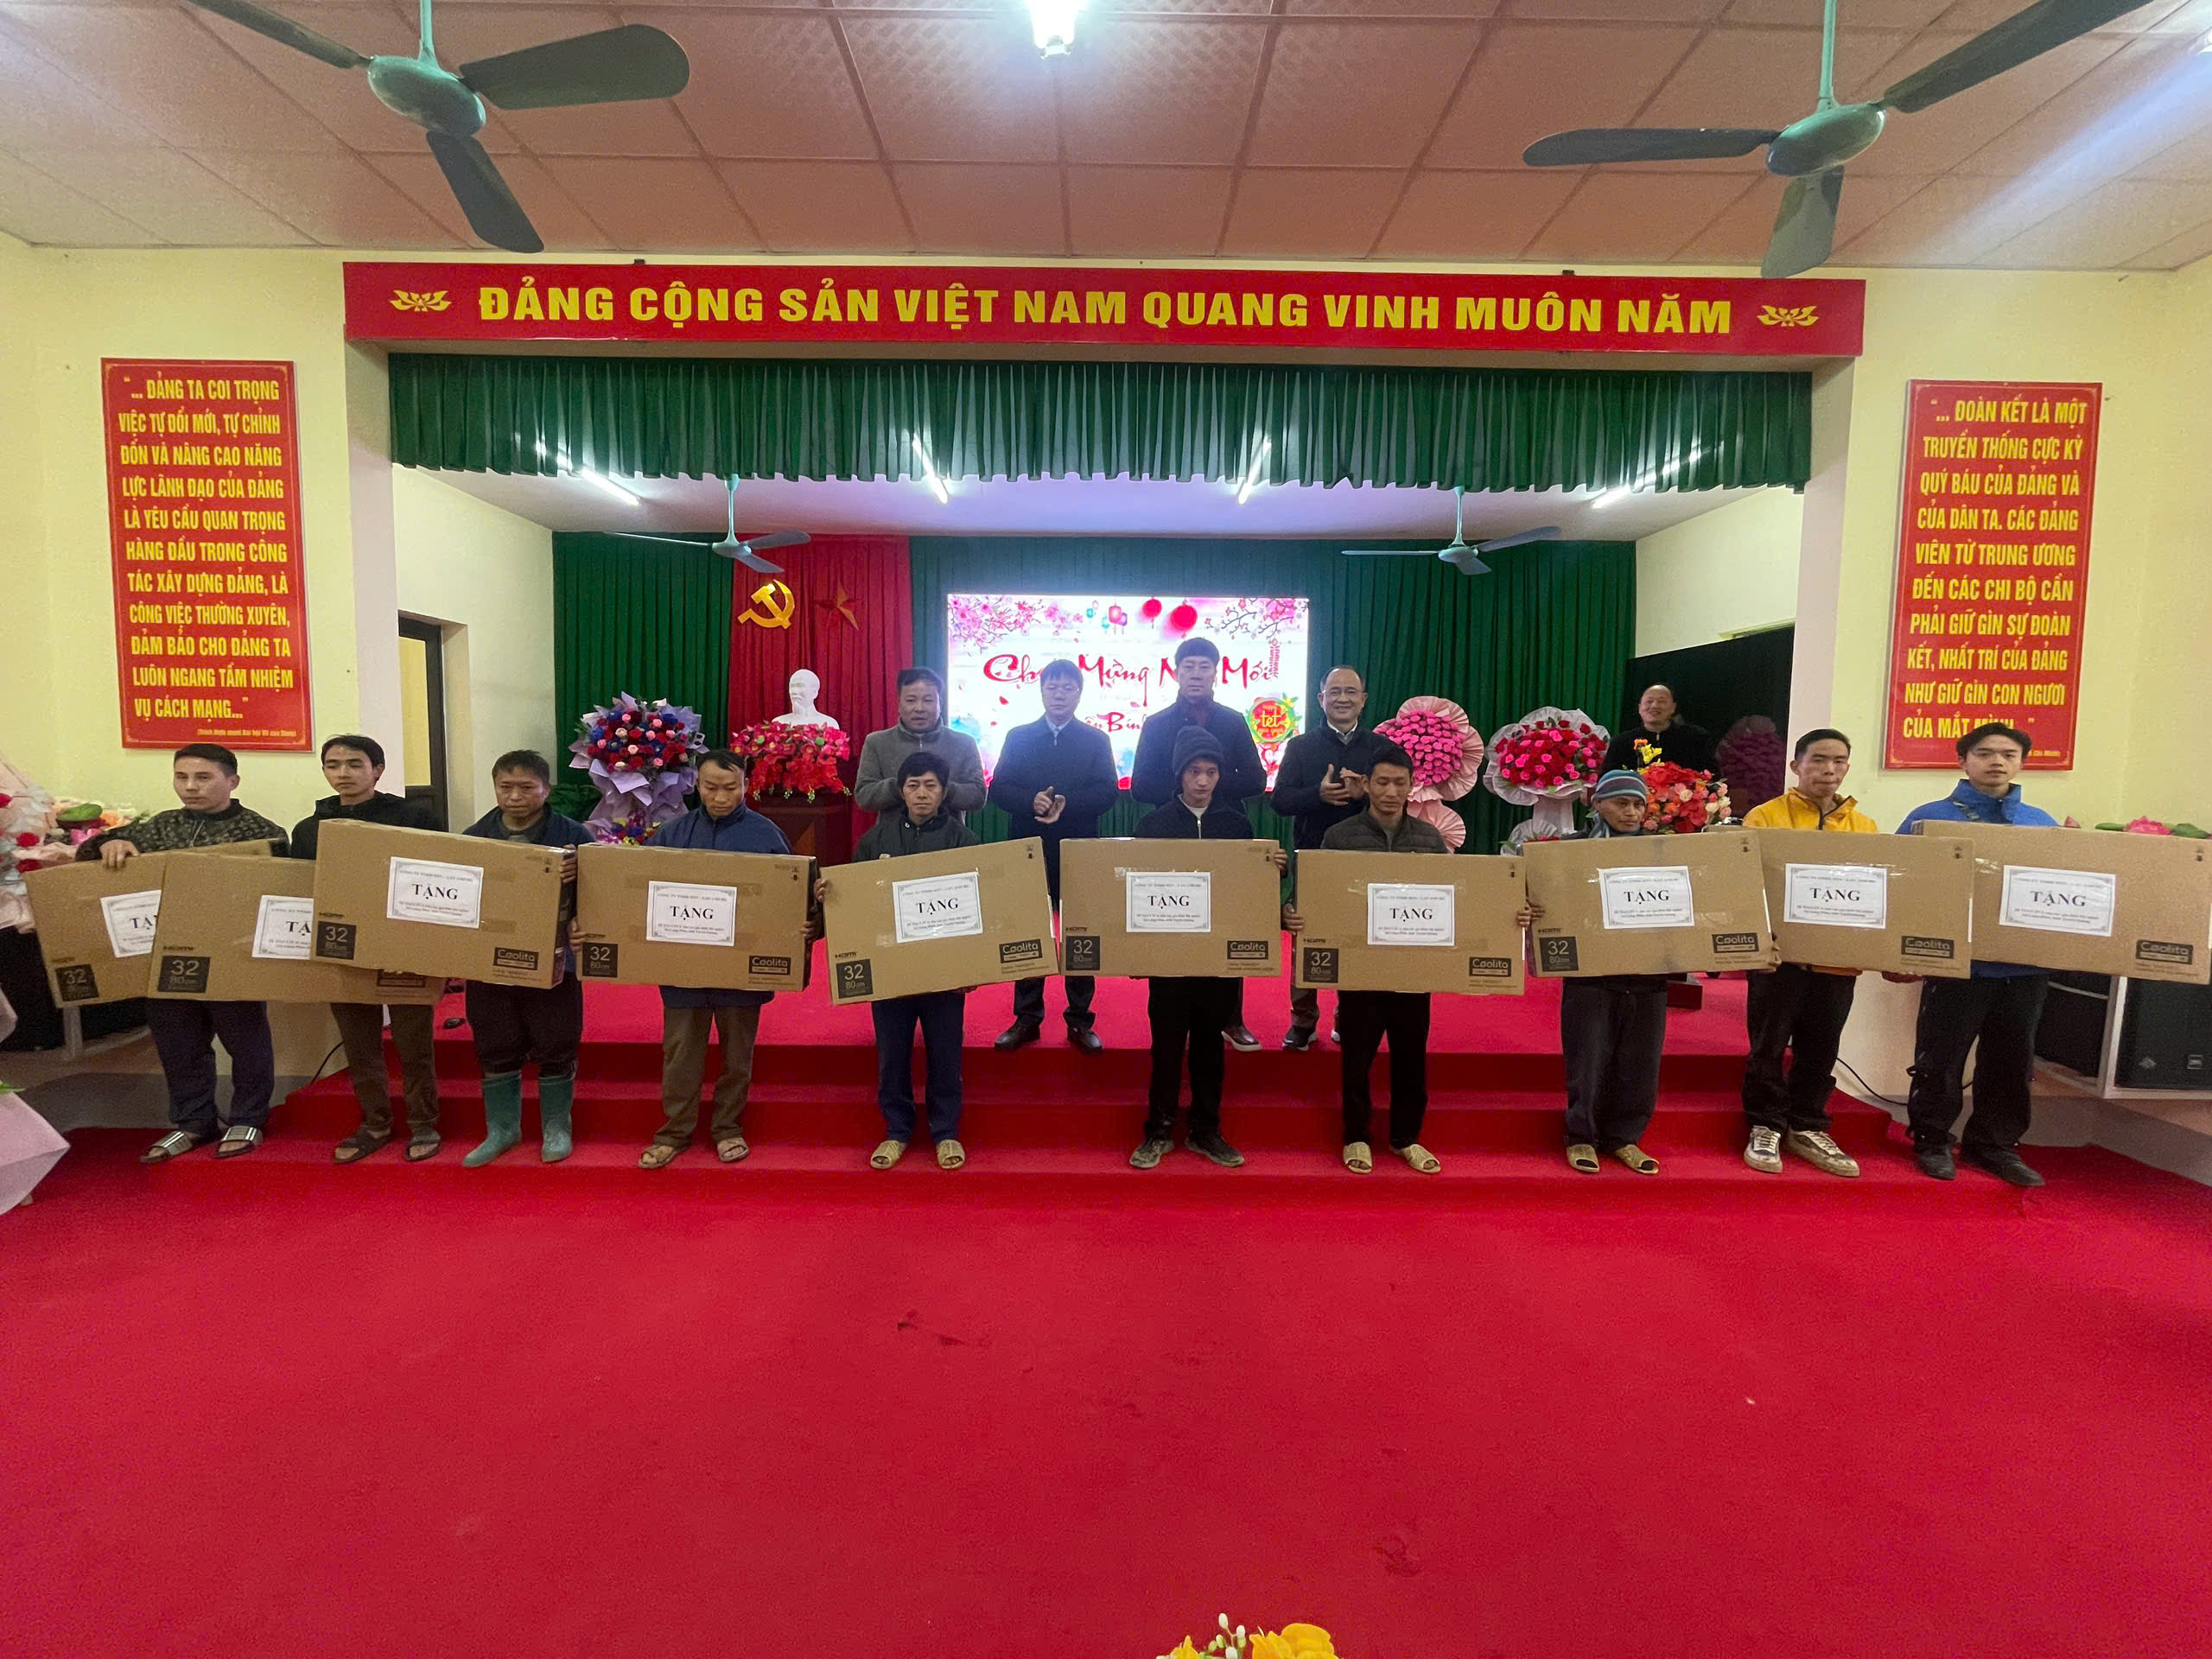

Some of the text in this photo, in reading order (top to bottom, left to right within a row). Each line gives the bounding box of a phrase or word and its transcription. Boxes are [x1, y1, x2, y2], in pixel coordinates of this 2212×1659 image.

[479, 276, 1731, 334] ĐẢNG CỘNG SẢN VIỆT NAM QUANG VINH MUÔN NĂM
[147, 372, 184, 399] ĐẢNG
[187, 380, 205, 399] TA
[207, 380, 231, 399] COI
[233, 380, 279, 404] TRỌNG
[118, 410, 146, 436] VIỆC
[149, 411, 166, 437] TỰ
[193, 408, 220, 435] MỚI,
[223, 412, 239, 438] TỰ
[242, 407, 280, 434] CHỈNH
[1955, 396, 1997, 422] ĐOÀN
[2000, 394, 2029, 423] KẾT
[2031, 397, 2050, 423] LÀ
[2055, 397, 2088, 429] MỘT
[151, 442, 169, 465] VÀ
[173, 442, 210, 466] NÂNG
[213, 446, 240, 466] CAO
[244, 442, 282, 467] NĂNG
[1923, 429, 1978, 459] TRUYỀN
[1982, 430, 2028, 459] THỐNG
[2032, 436, 2060, 465] CỰC
[123, 470, 283, 501] LỰC LÃNH ĐẠO CỦA ĐẢNG
[1920, 463, 2080, 496] QUÝ BÁU CỦA ĐẢNG VÀ
[124, 504, 285, 535] LÀ YÊU CẦU QUAN TRỌNG
[1917, 499, 2078, 531] CỦA DÂN TA. CÁC ĐẢNG
[126, 536, 287, 563] HÀNG ĐẦU TRONG CÔNG
[1916, 539, 1950, 564] VIÊN
[1978, 544, 2028, 565] TRUNG
[2032, 543, 2076, 566] ƯƠNG
[127, 567, 289, 596] TÁC XÂY DỰNG ĐẢNG, LÀ
[1912, 571, 2074, 605] ĐẾN CÁC CHI BỘ CẦN
[130, 601, 290, 628] CÔNG VIỆC THƯỜNG XUYÊN,
[1910, 605, 1945, 634] PHẢI
[2006, 613, 2029, 643] SỰ
[2031, 611, 2070, 636] ĐOÀN
[131, 628, 291, 657] ĐẢM BẢO CHO ĐẢNG TA
[1939, 642, 1974, 670] NHẤT
[1978, 645, 1999, 670] TRÍ
[2001, 639, 2027, 671] CỦA
[2031, 641, 2068, 671] ĐẢNG
[133, 663, 293, 692] LUÔN NGANG TẦM NHIỆM
[1904, 681, 1936, 704] NHƯ
[1992, 684, 2020, 704] CON
[135, 698, 151, 721] VỤ
[155, 695, 189, 717] CÁCH
[1903, 709, 1933, 738] CỦA
[1937, 711, 1970, 739] MẮT
[411, 883, 458, 900] TẶNG
[1147, 893, 1190, 909] TẶNG
[1624, 889, 1669, 905] TẶNG
[1809, 887, 1860, 903] TẶNG
[2030, 890, 2087, 907] TẶNG
[670, 905, 714, 920] TẶNG
[916, 898, 958, 914] TẶNG
[1389, 906, 1433, 922] TẶNG
[131, 914, 157, 931] TẶ
[286, 920, 311, 936] TẶ
[325, 925, 348, 943] 32
[589, 946, 611, 962] 32
[1073, 939, 1093, 954] 32
[1311, 951, 1332, 966] 32
[1548, 940, 1569, 956] 32
[171, 960, 200, 976] 32
[844, 963, 864, 980] 32
